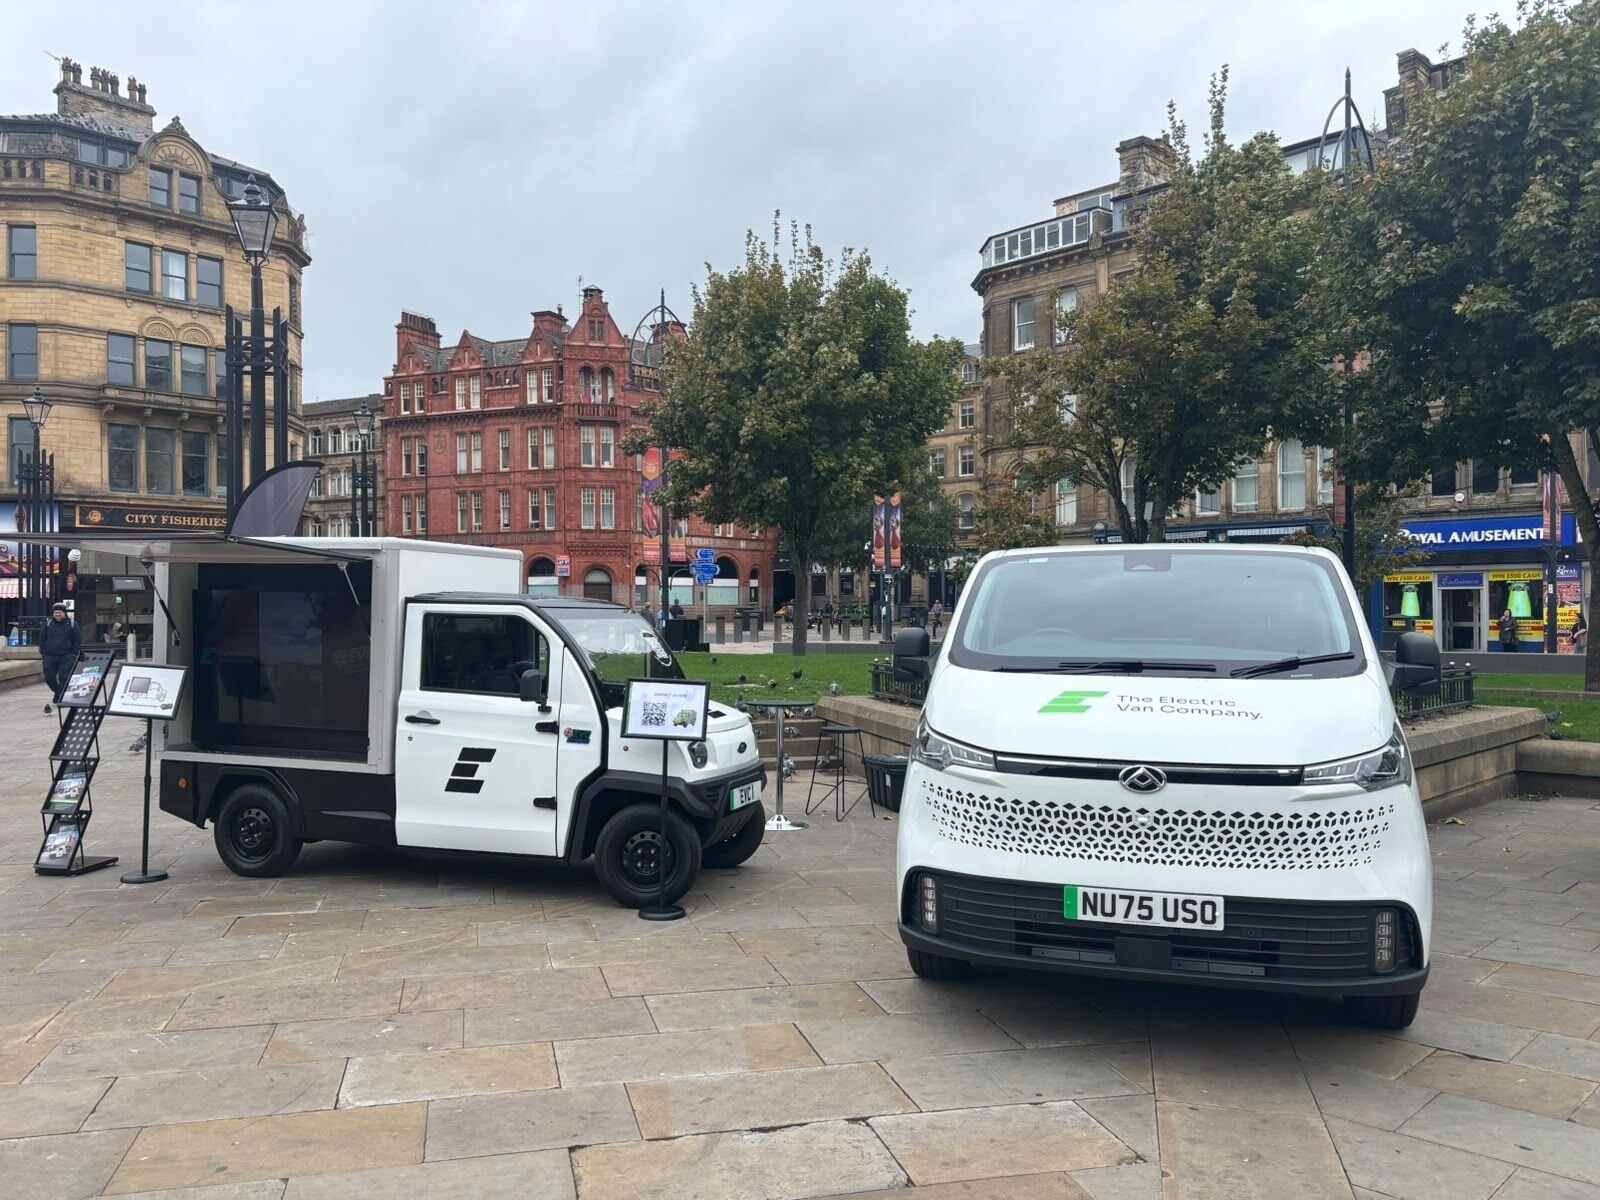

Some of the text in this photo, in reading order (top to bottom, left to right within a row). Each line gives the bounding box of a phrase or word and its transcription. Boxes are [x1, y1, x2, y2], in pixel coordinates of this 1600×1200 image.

[125, 513, 228, 527] CITY FISHERIES
[1117, 695, 1236, 707] The Electric
[1116, 703, 1263, 720] Van Company.
[1082, 891, 1217, 925] NU75 USO
